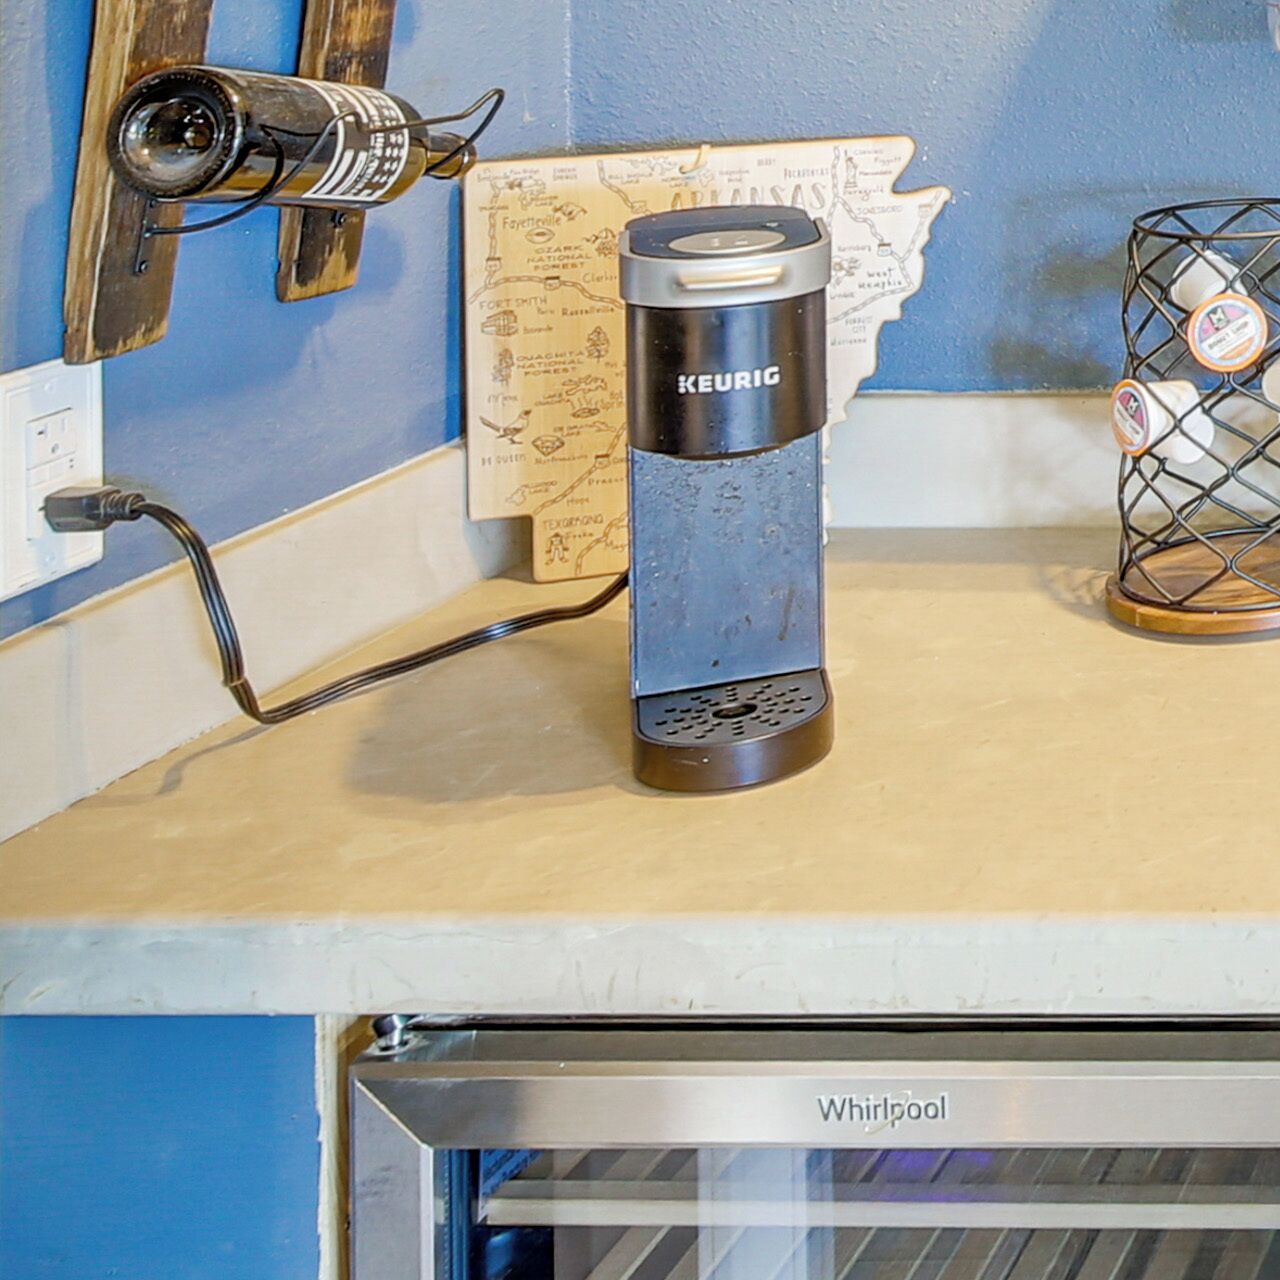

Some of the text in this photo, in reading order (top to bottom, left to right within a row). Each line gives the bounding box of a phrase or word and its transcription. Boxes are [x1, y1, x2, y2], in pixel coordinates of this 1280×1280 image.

[535, 245, 584, 254] OZARK
[527, 254, 593, 263] NATIONAL
[534, 263, 585, 271] FOREST
[480, 296, 547, 310] FORT SMITH
[516, 351, 585, 362] OUACHITA
[516, 359, 585, 370] NATIONAL
[524, 367, 577, 376] FOREST
[678, 365, 780, 394] KEURIG
[817, 1095, 946, 1128] Whirlpool
